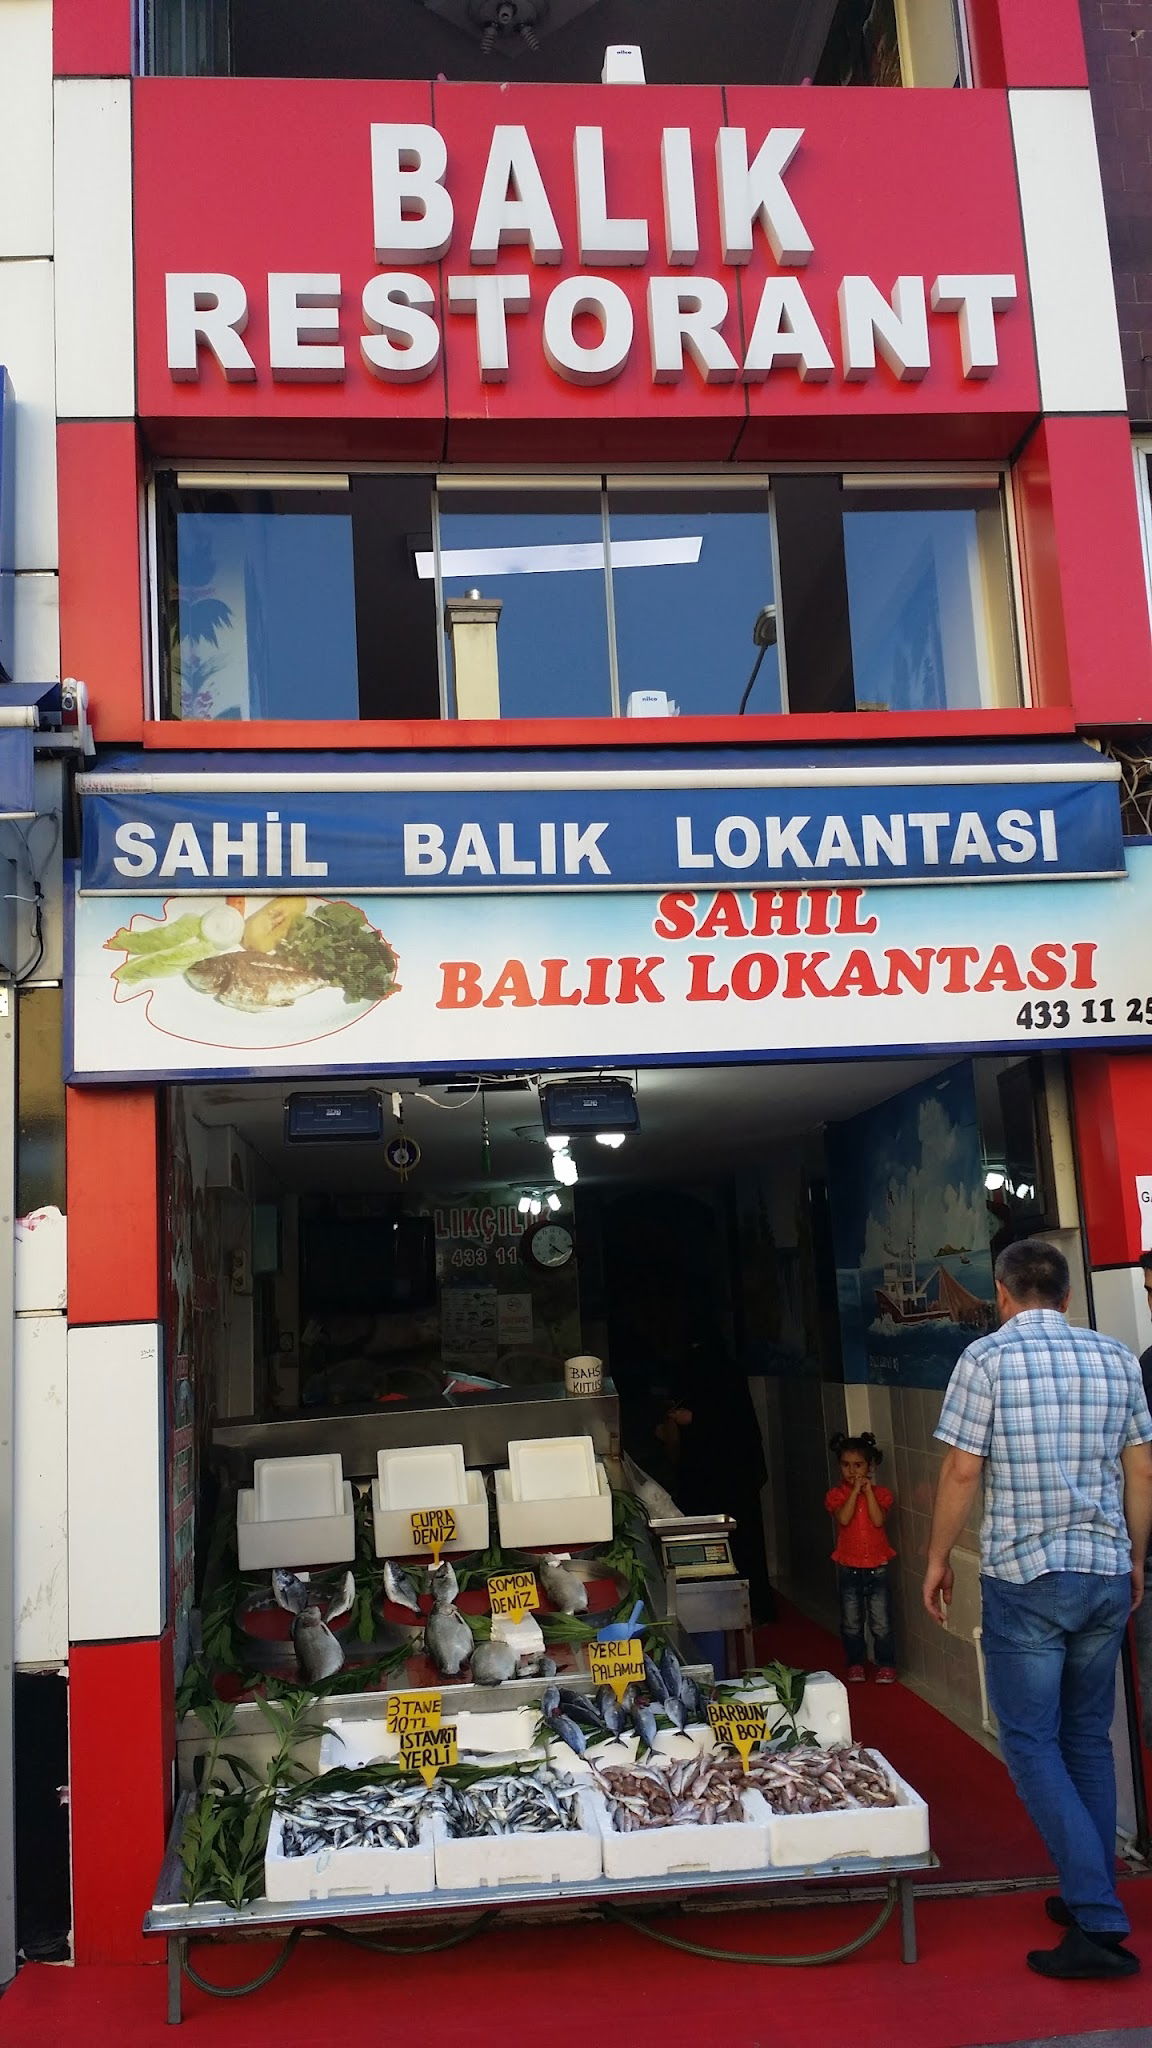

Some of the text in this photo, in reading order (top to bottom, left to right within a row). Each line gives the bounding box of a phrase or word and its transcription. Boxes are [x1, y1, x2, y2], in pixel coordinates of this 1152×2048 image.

[370, 122, 815, 266] BALIK
[164, 271, 1017, 387] RESTORANT
[112, 809, 1060, 878] SAHİL BALIK LOKANTASI
[654, 887, 877, 940] SAHIL
[435, 942, 1098, 1010] BALIK LOKANTASI
[1016, 1000, 1070, 1030] 433
[1081, 998, 1116, 1024] 11
[1141, 1191, 1152, 1203] G
[400, 1205, 552, 1245] LIKÇIL
[451, 1246, 518, 1267] 433 11
[411, 1509, 455, 1529] ÇUPRA
[489, 1573, 534, 1594] SOMON
[491, 1590, 534, 1614] DENİZ
[592, 1662, 645, 1683] PALAMUT
[388, 1696, 441, 1716] 3 TANE
[708, 1705, 764, 1722] BARBUN
[388, 1716, 408, 1733] 10
[736, 1723, 766, 1740] BOY
[400, 1745, 450, 1769] YERLİ
